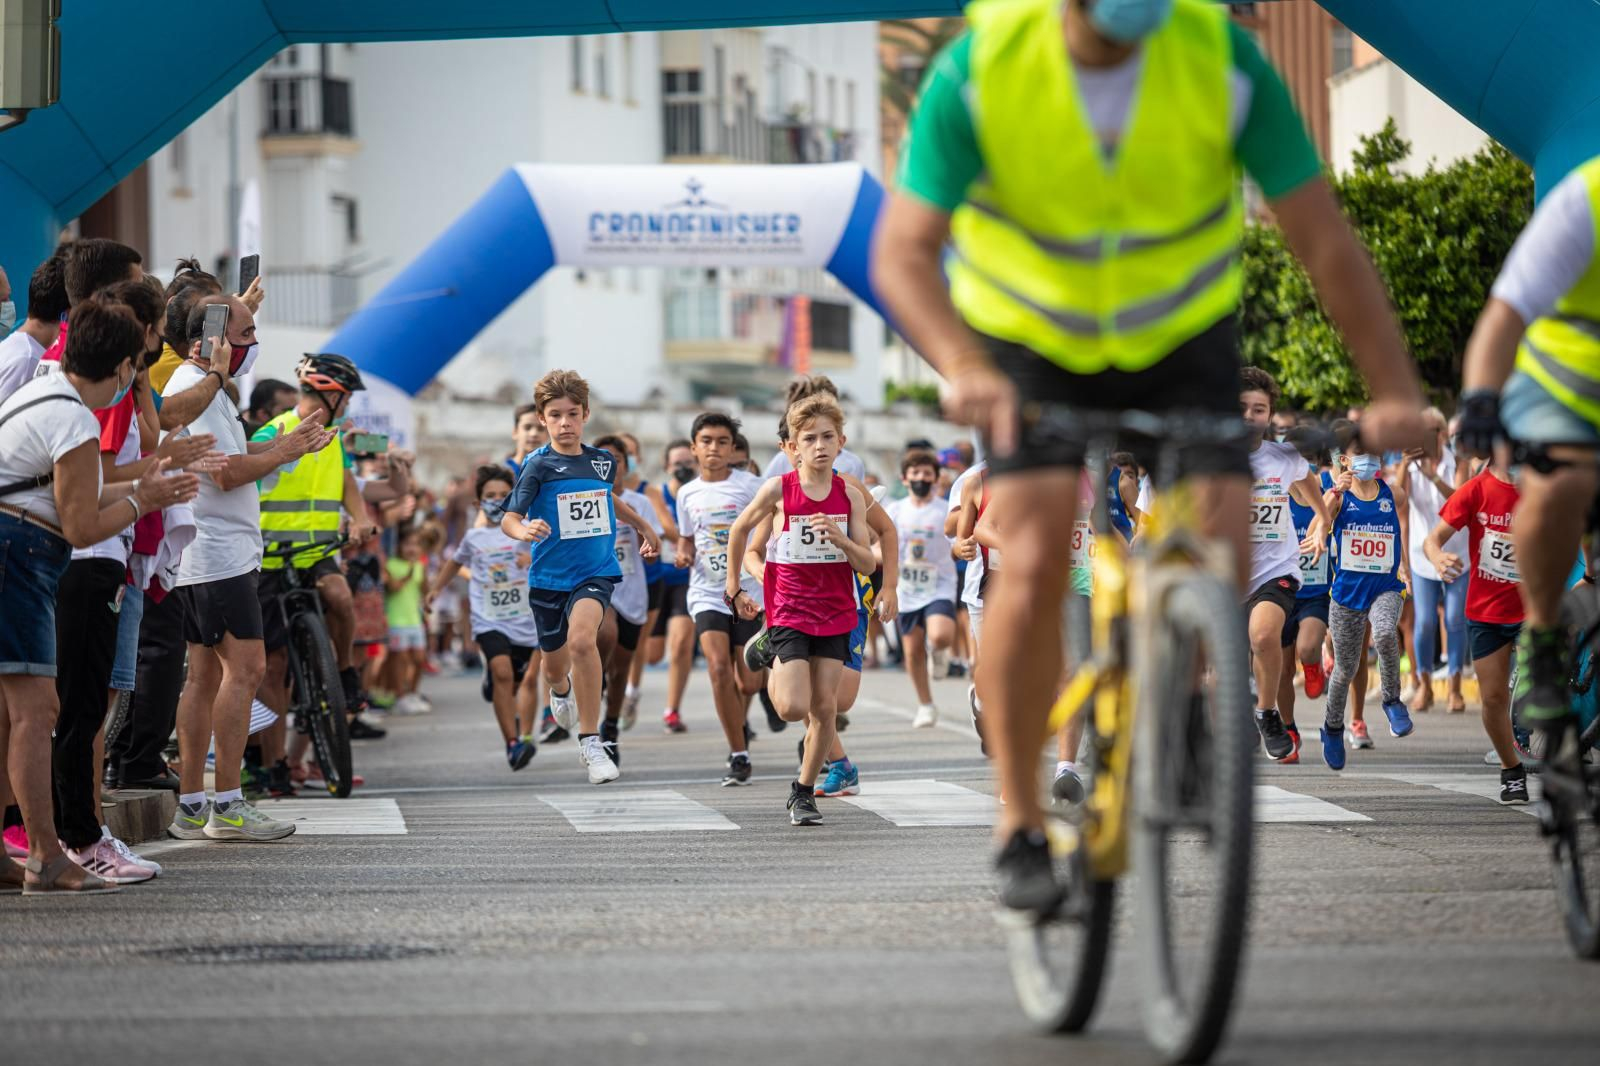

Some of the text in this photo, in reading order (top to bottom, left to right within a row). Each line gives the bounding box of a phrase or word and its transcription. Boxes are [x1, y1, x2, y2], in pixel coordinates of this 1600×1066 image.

[588, 212, 802, 242] CRONOFINISHER
[570, 500, 600, 520] 521
[1247, 505, 1282, 524] 527
[1350, 538, 1386, 558] 509
[1490, 541, 1517, 562] 52
[491, 588, 521, 606] 528
